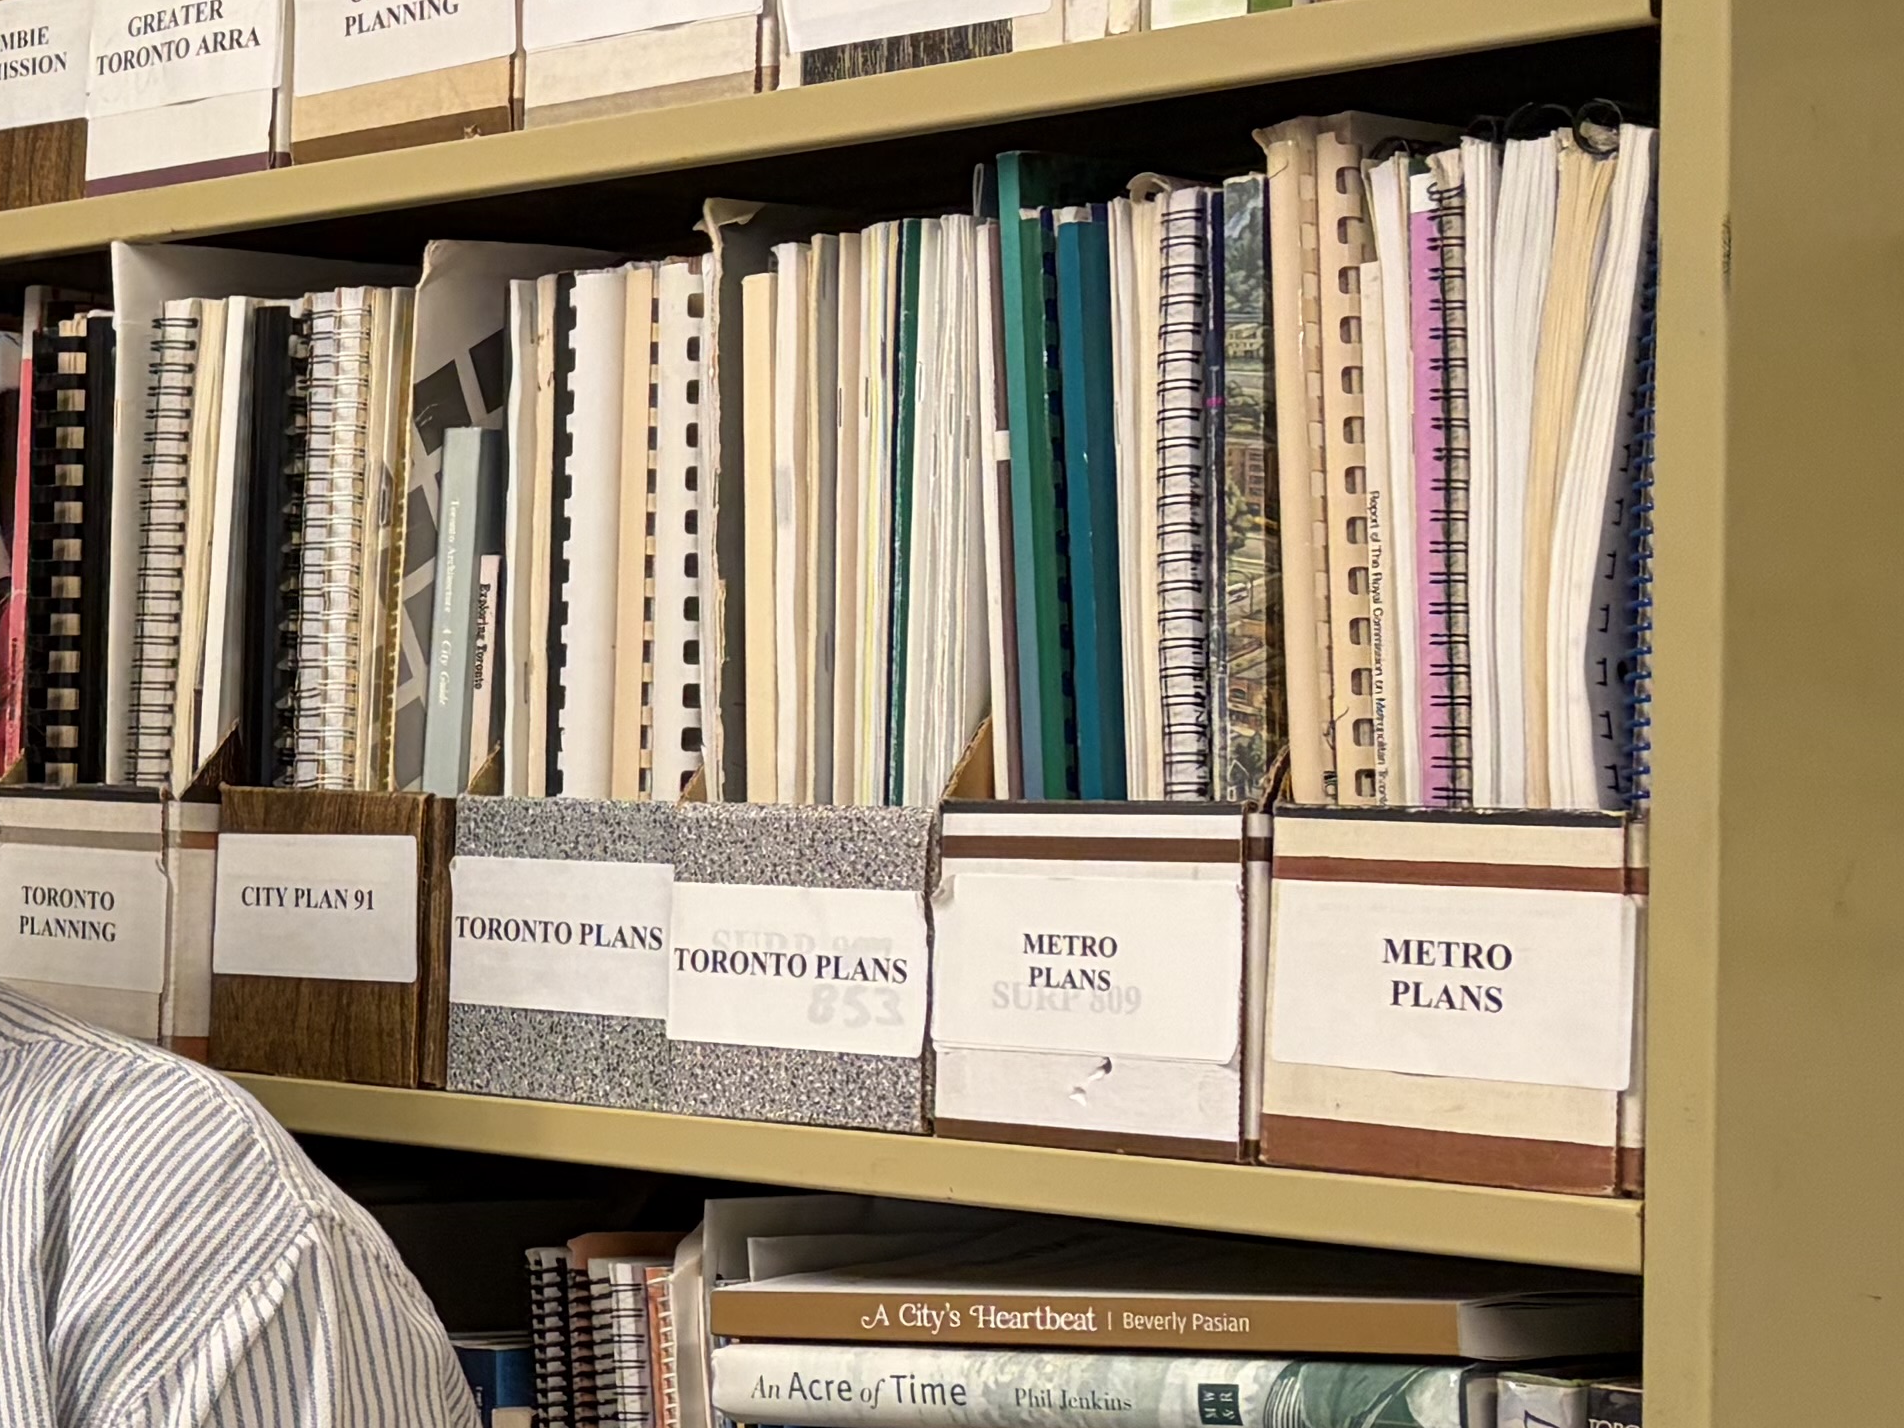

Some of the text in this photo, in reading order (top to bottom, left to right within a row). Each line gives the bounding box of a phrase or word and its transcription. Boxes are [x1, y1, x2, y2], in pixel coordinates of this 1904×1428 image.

[96, 23, 261, 76] TORONTO ARRA
[21, 883, 115, 912] TORONTO
[241, 883, 376, 910] CITY PLAN 91
[19, 912, 117, 943] PLANNING
[454, 914, 663, 950] TORONTO PLANS
[1023, 933, 1118, 960] METRO
[1382, 936, 1513, 972] METRO
[674, 946, 908, 983] TORONTO PLANS
[1028, 963, 1112, 992] PLANS
[1389, 978, 1504, 1014] PLANS
[862, 1301, 1098, 1337] A City's Heartbeat
[750, 1372, 967, 1406] An Acre of Time
